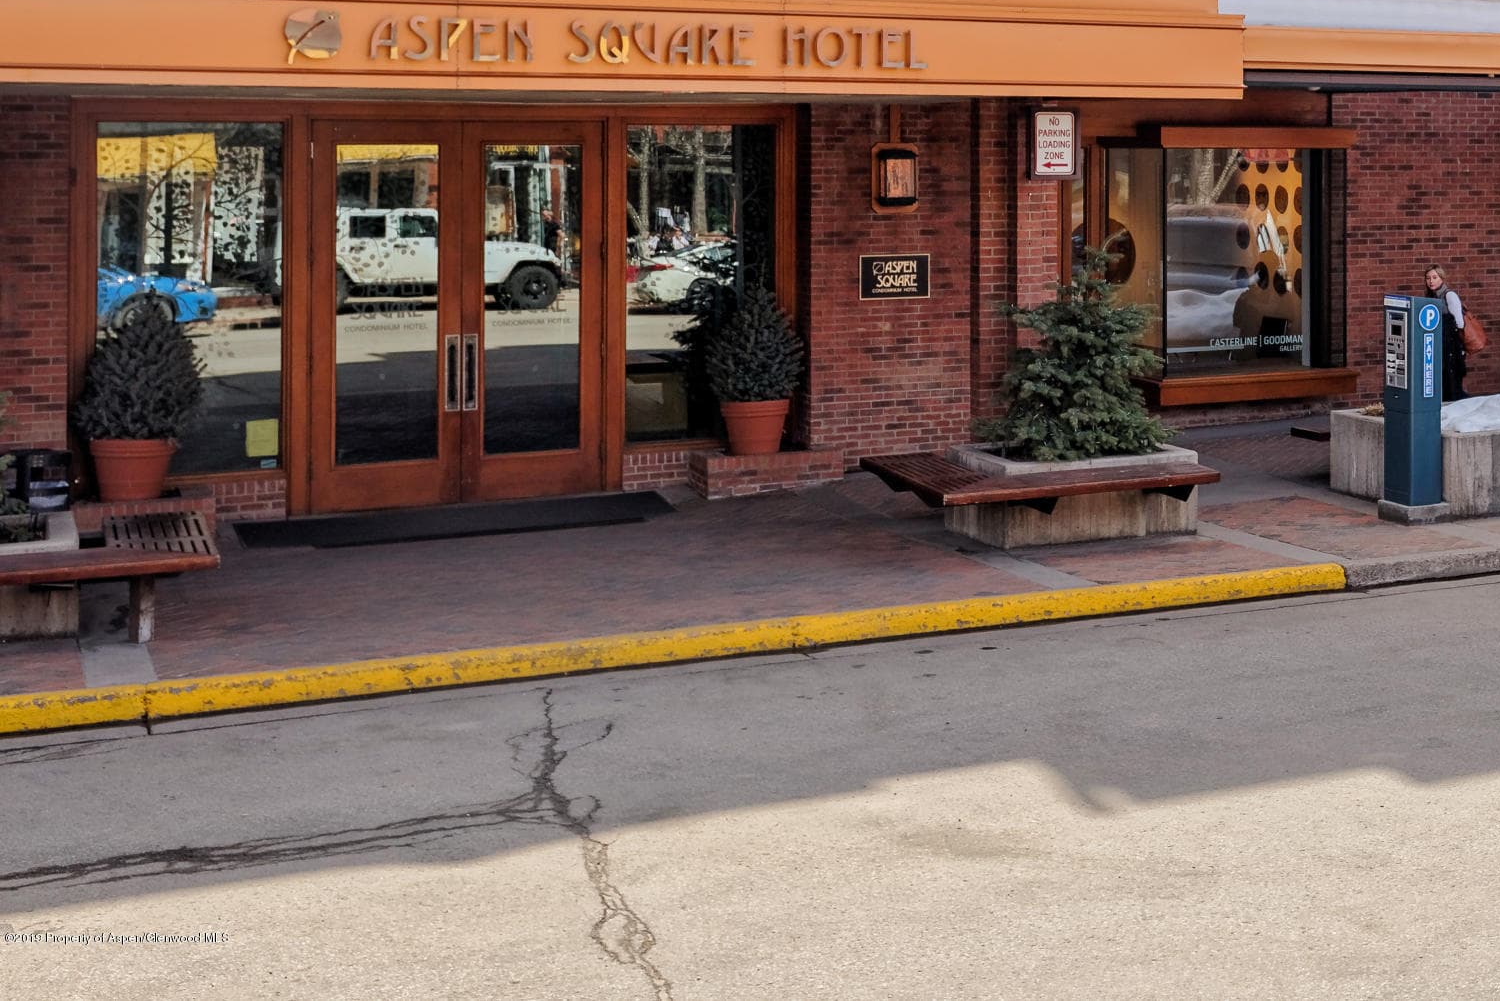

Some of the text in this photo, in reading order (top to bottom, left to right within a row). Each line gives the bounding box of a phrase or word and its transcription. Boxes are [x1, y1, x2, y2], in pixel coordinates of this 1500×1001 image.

[369, 14, 929, 70] ASPEN SQUARE HOTEL
[1048, 117, 1060, 127] NO
[1038, 129, 1071, 138] PARKING
[1038, 140, 1071, 149] LOADING
[1044, 151, 1065, 160] ZONE
[885, 260, 917, 274] ASPEN
[875, 274, 918, 287] SQUARE
[1426, 309, 1436, 327] P
[1210, 335, 1304, 347] CASTERLINE GOODMAN
[1425, 336, 1433, 395] PAY HERE
